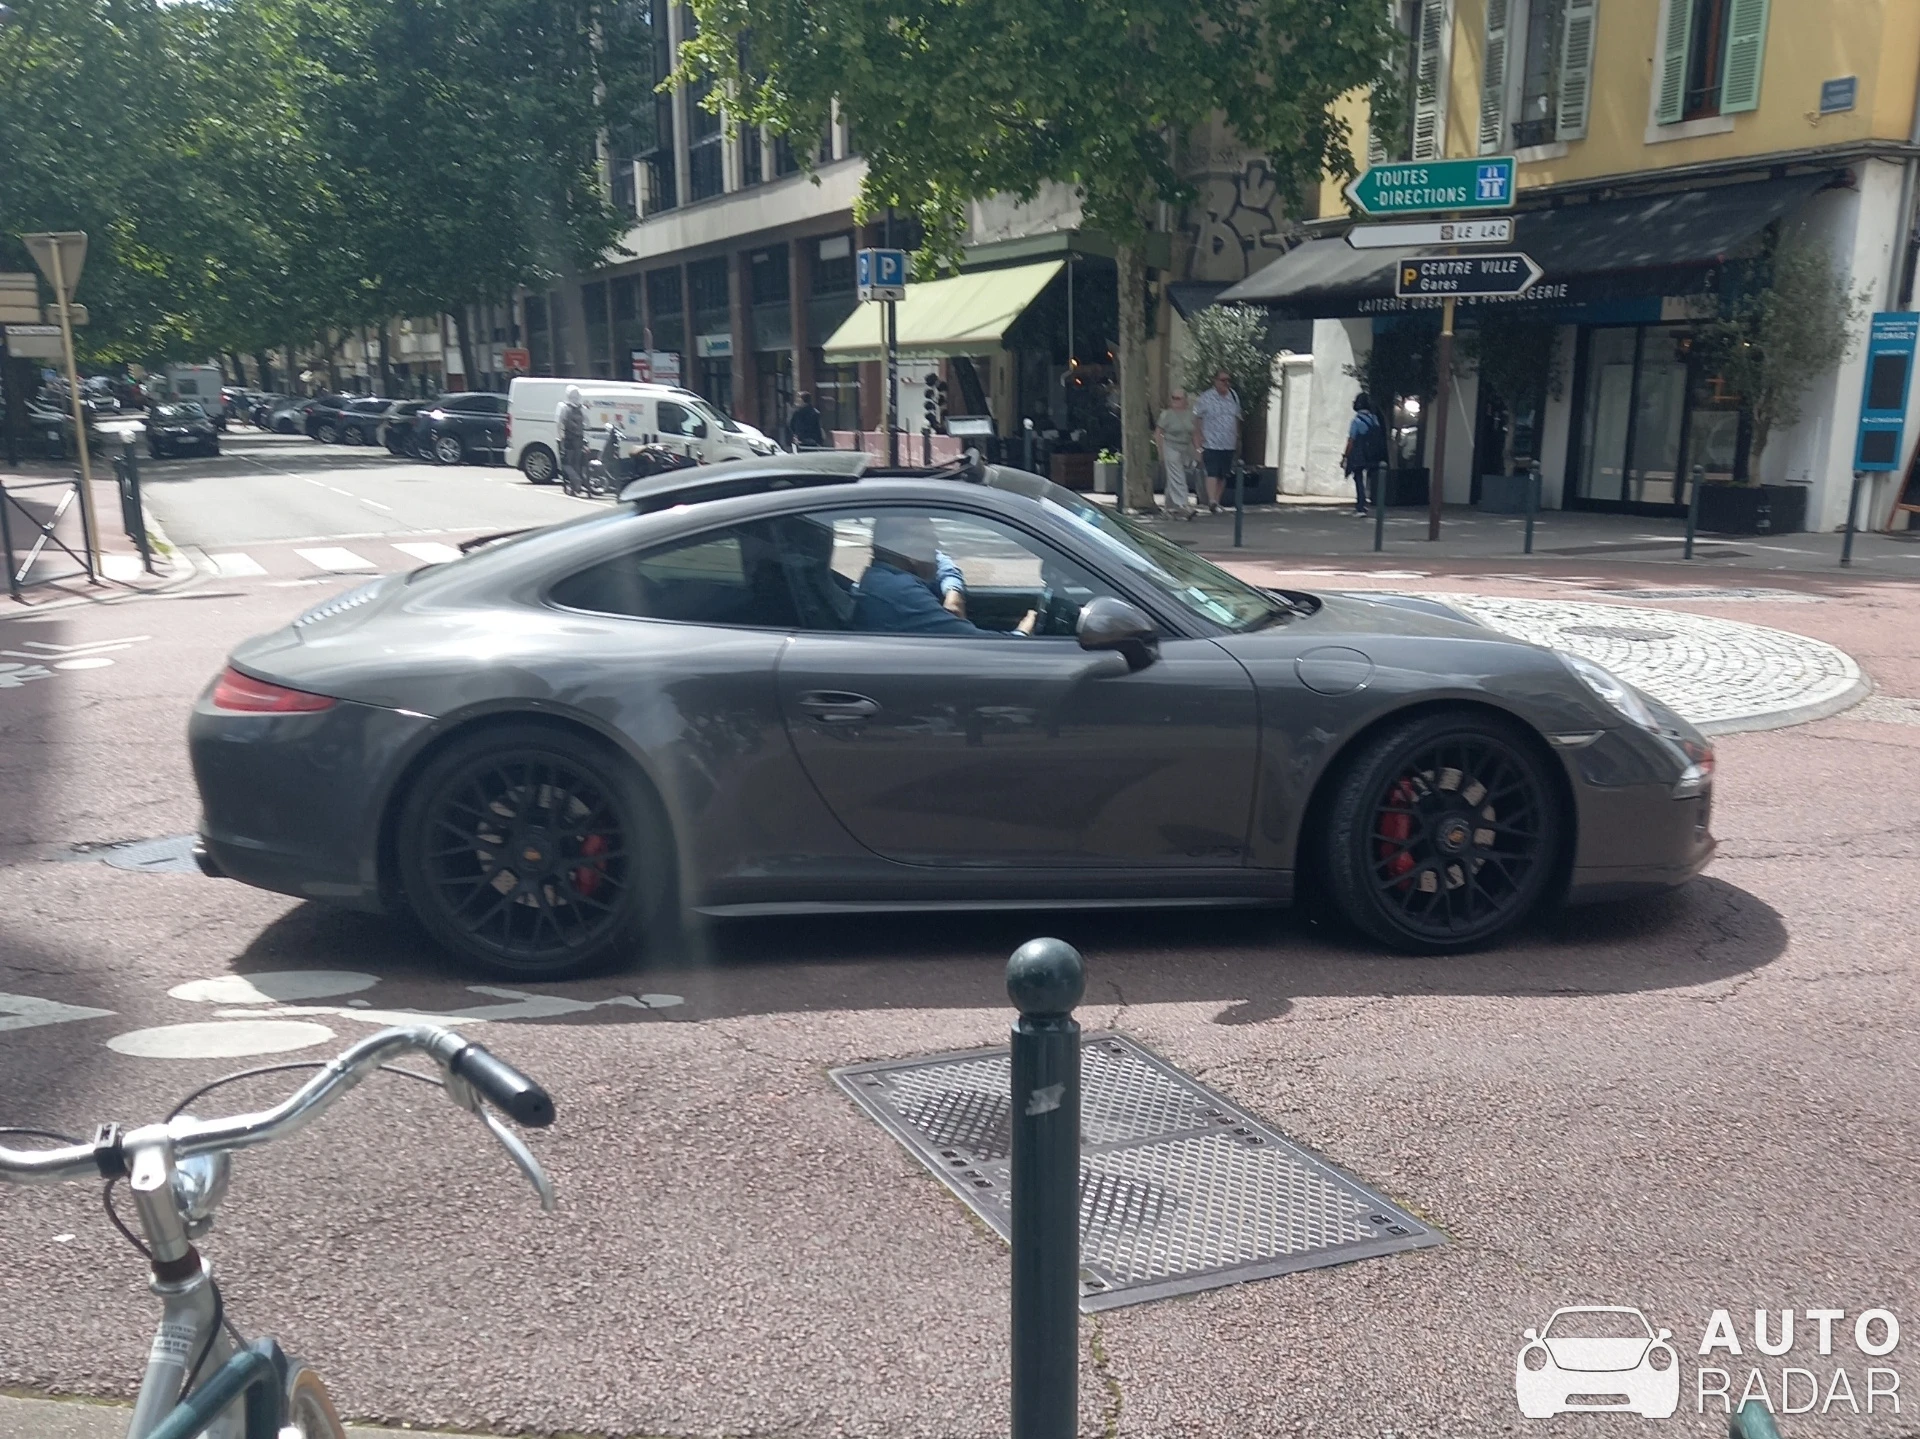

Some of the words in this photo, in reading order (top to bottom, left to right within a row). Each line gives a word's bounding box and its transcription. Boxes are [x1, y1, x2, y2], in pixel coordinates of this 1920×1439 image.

[1374, 168, 1429, 187] TOUTES
[1457, 225, 1473, 239] LE
[1480, 224, 1507, 238] LAC
[881, 256, 896, 281] P
[1420, 261, 1474, 276] CENTRE
[1481, 259, 1519, 274] VILLE
[1403, 267, 1418, 287] P
[1420, 277, 1459, 291] Gares
[1357, 297, 1408, 312] LAITERIE
